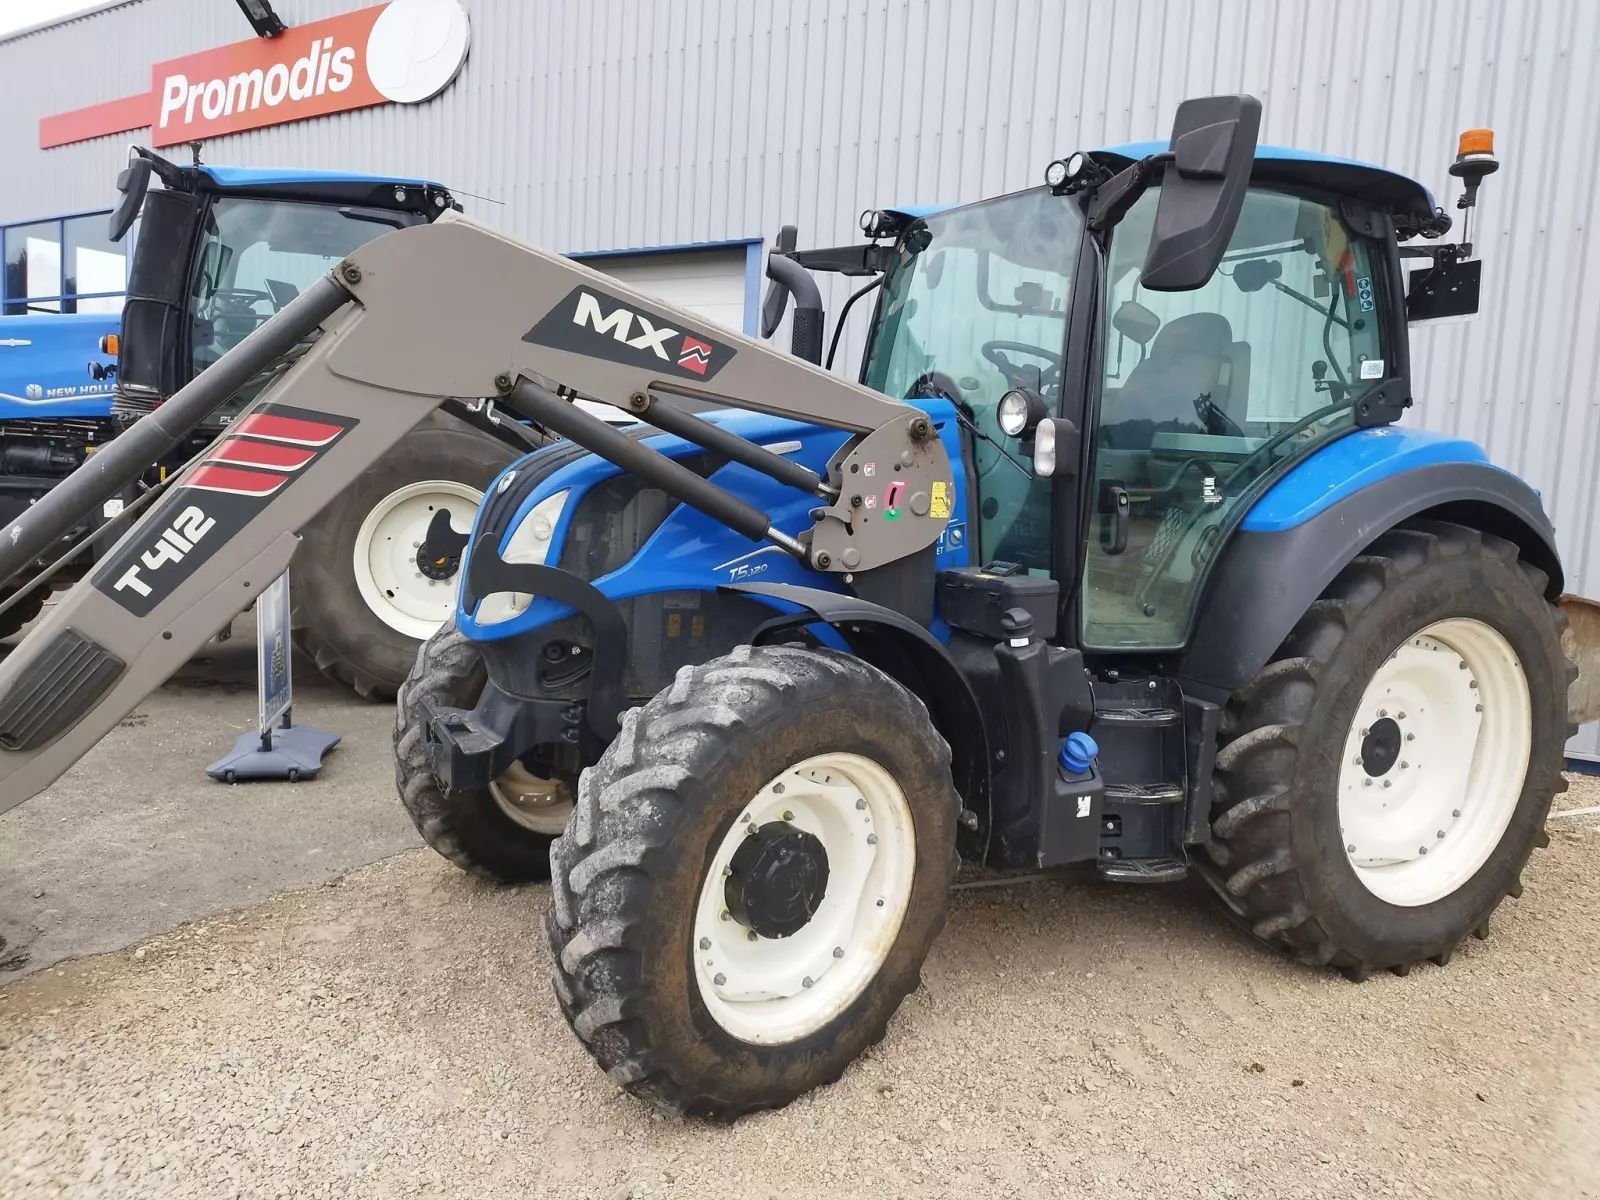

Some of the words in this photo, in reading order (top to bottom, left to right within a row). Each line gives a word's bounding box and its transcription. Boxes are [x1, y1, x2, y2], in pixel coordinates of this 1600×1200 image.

[160, 36, 356, 128] Promodis
[572, 291, 680, 362] MX
[47, 387, 76, 398] NEW
